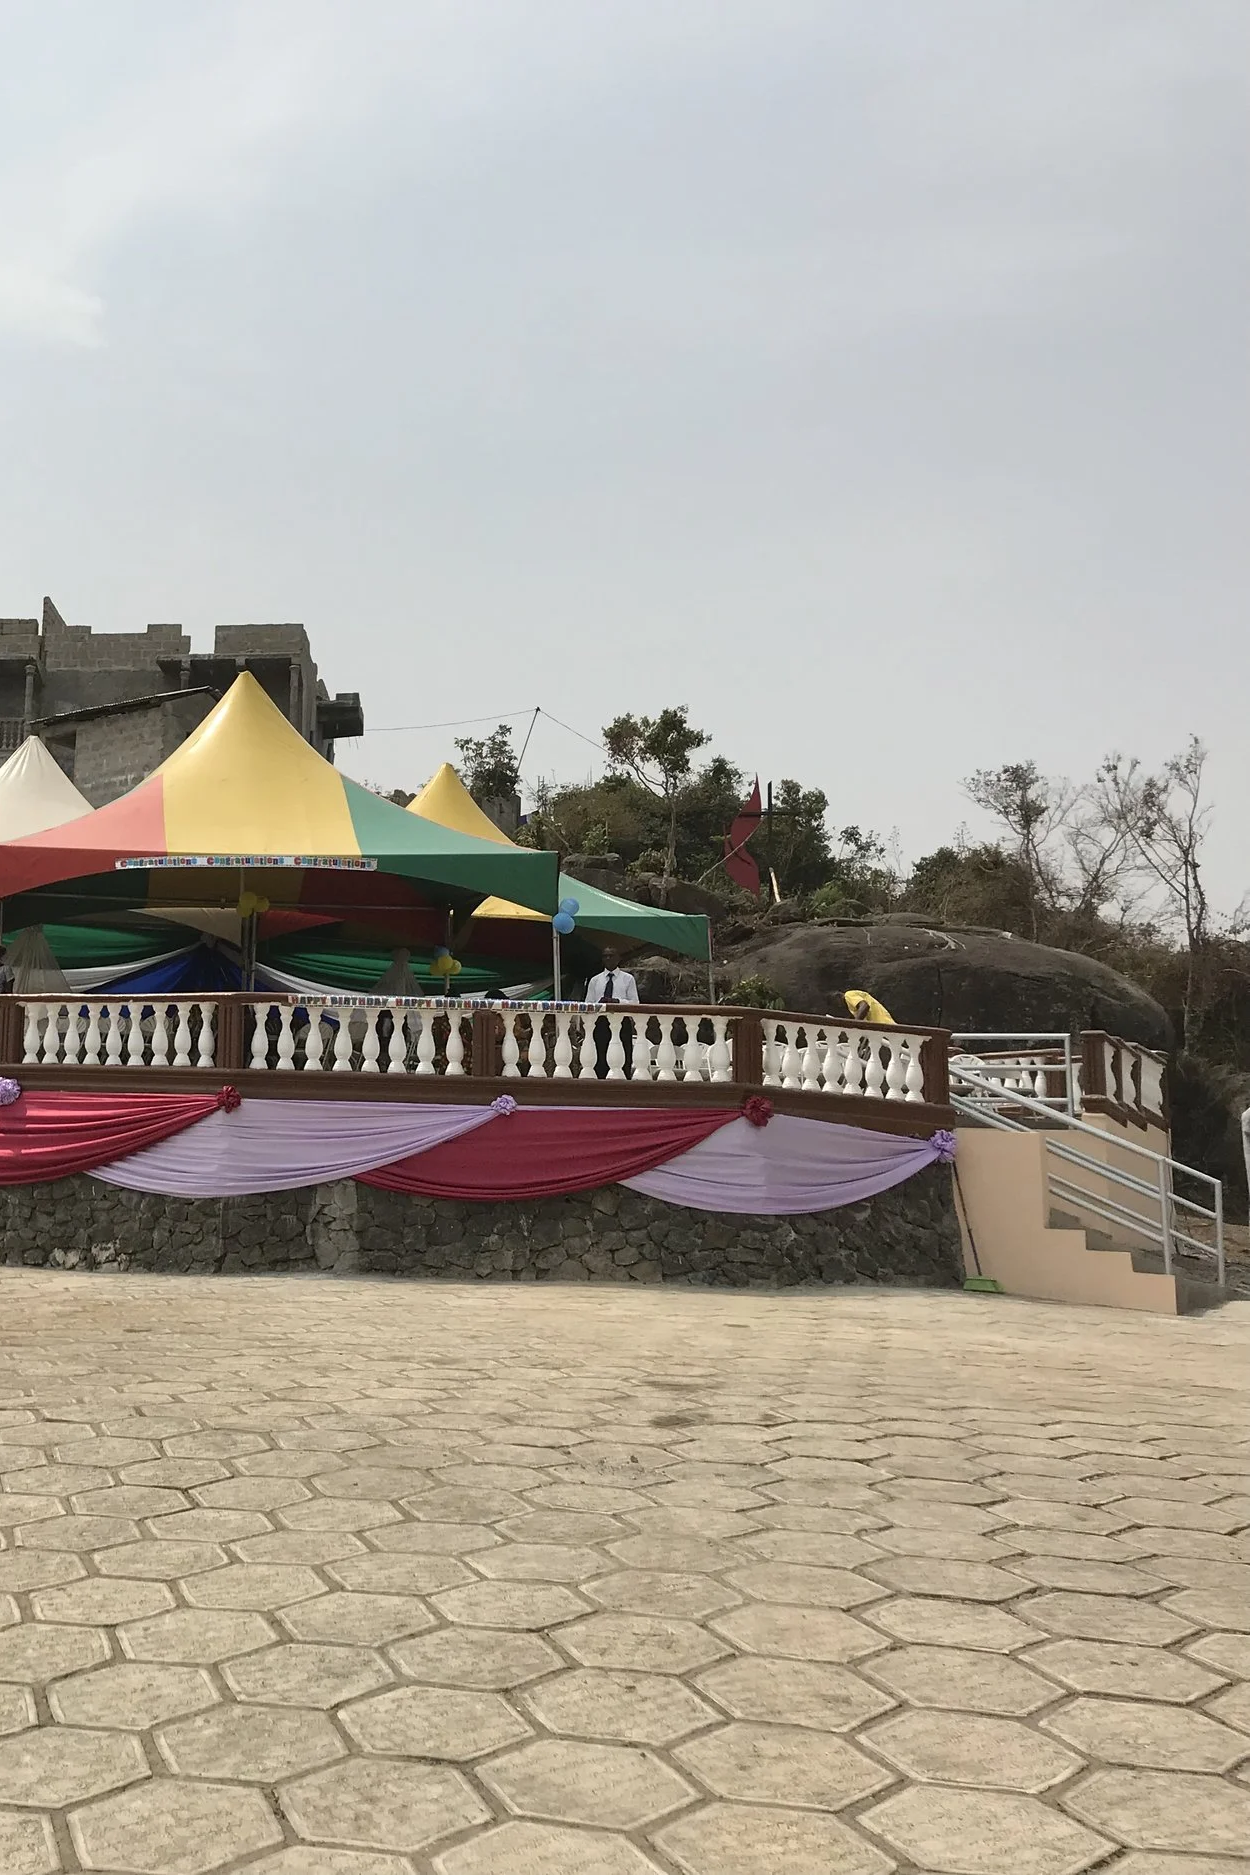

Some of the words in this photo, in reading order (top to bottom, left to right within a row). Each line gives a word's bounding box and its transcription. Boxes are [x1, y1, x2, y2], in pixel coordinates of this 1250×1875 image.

[291, 995, 327, 1005] HAPPY
[330, 996, 389, 1006] BIRTHDAY
[395, 998, 432, 1007] HAPPY
[435, 998, 494, 1009] BIRTHDAY
[501, 1000, 538, 1010] HAPPY
[542, 1001, 603, 1012] BIRTHDAY
